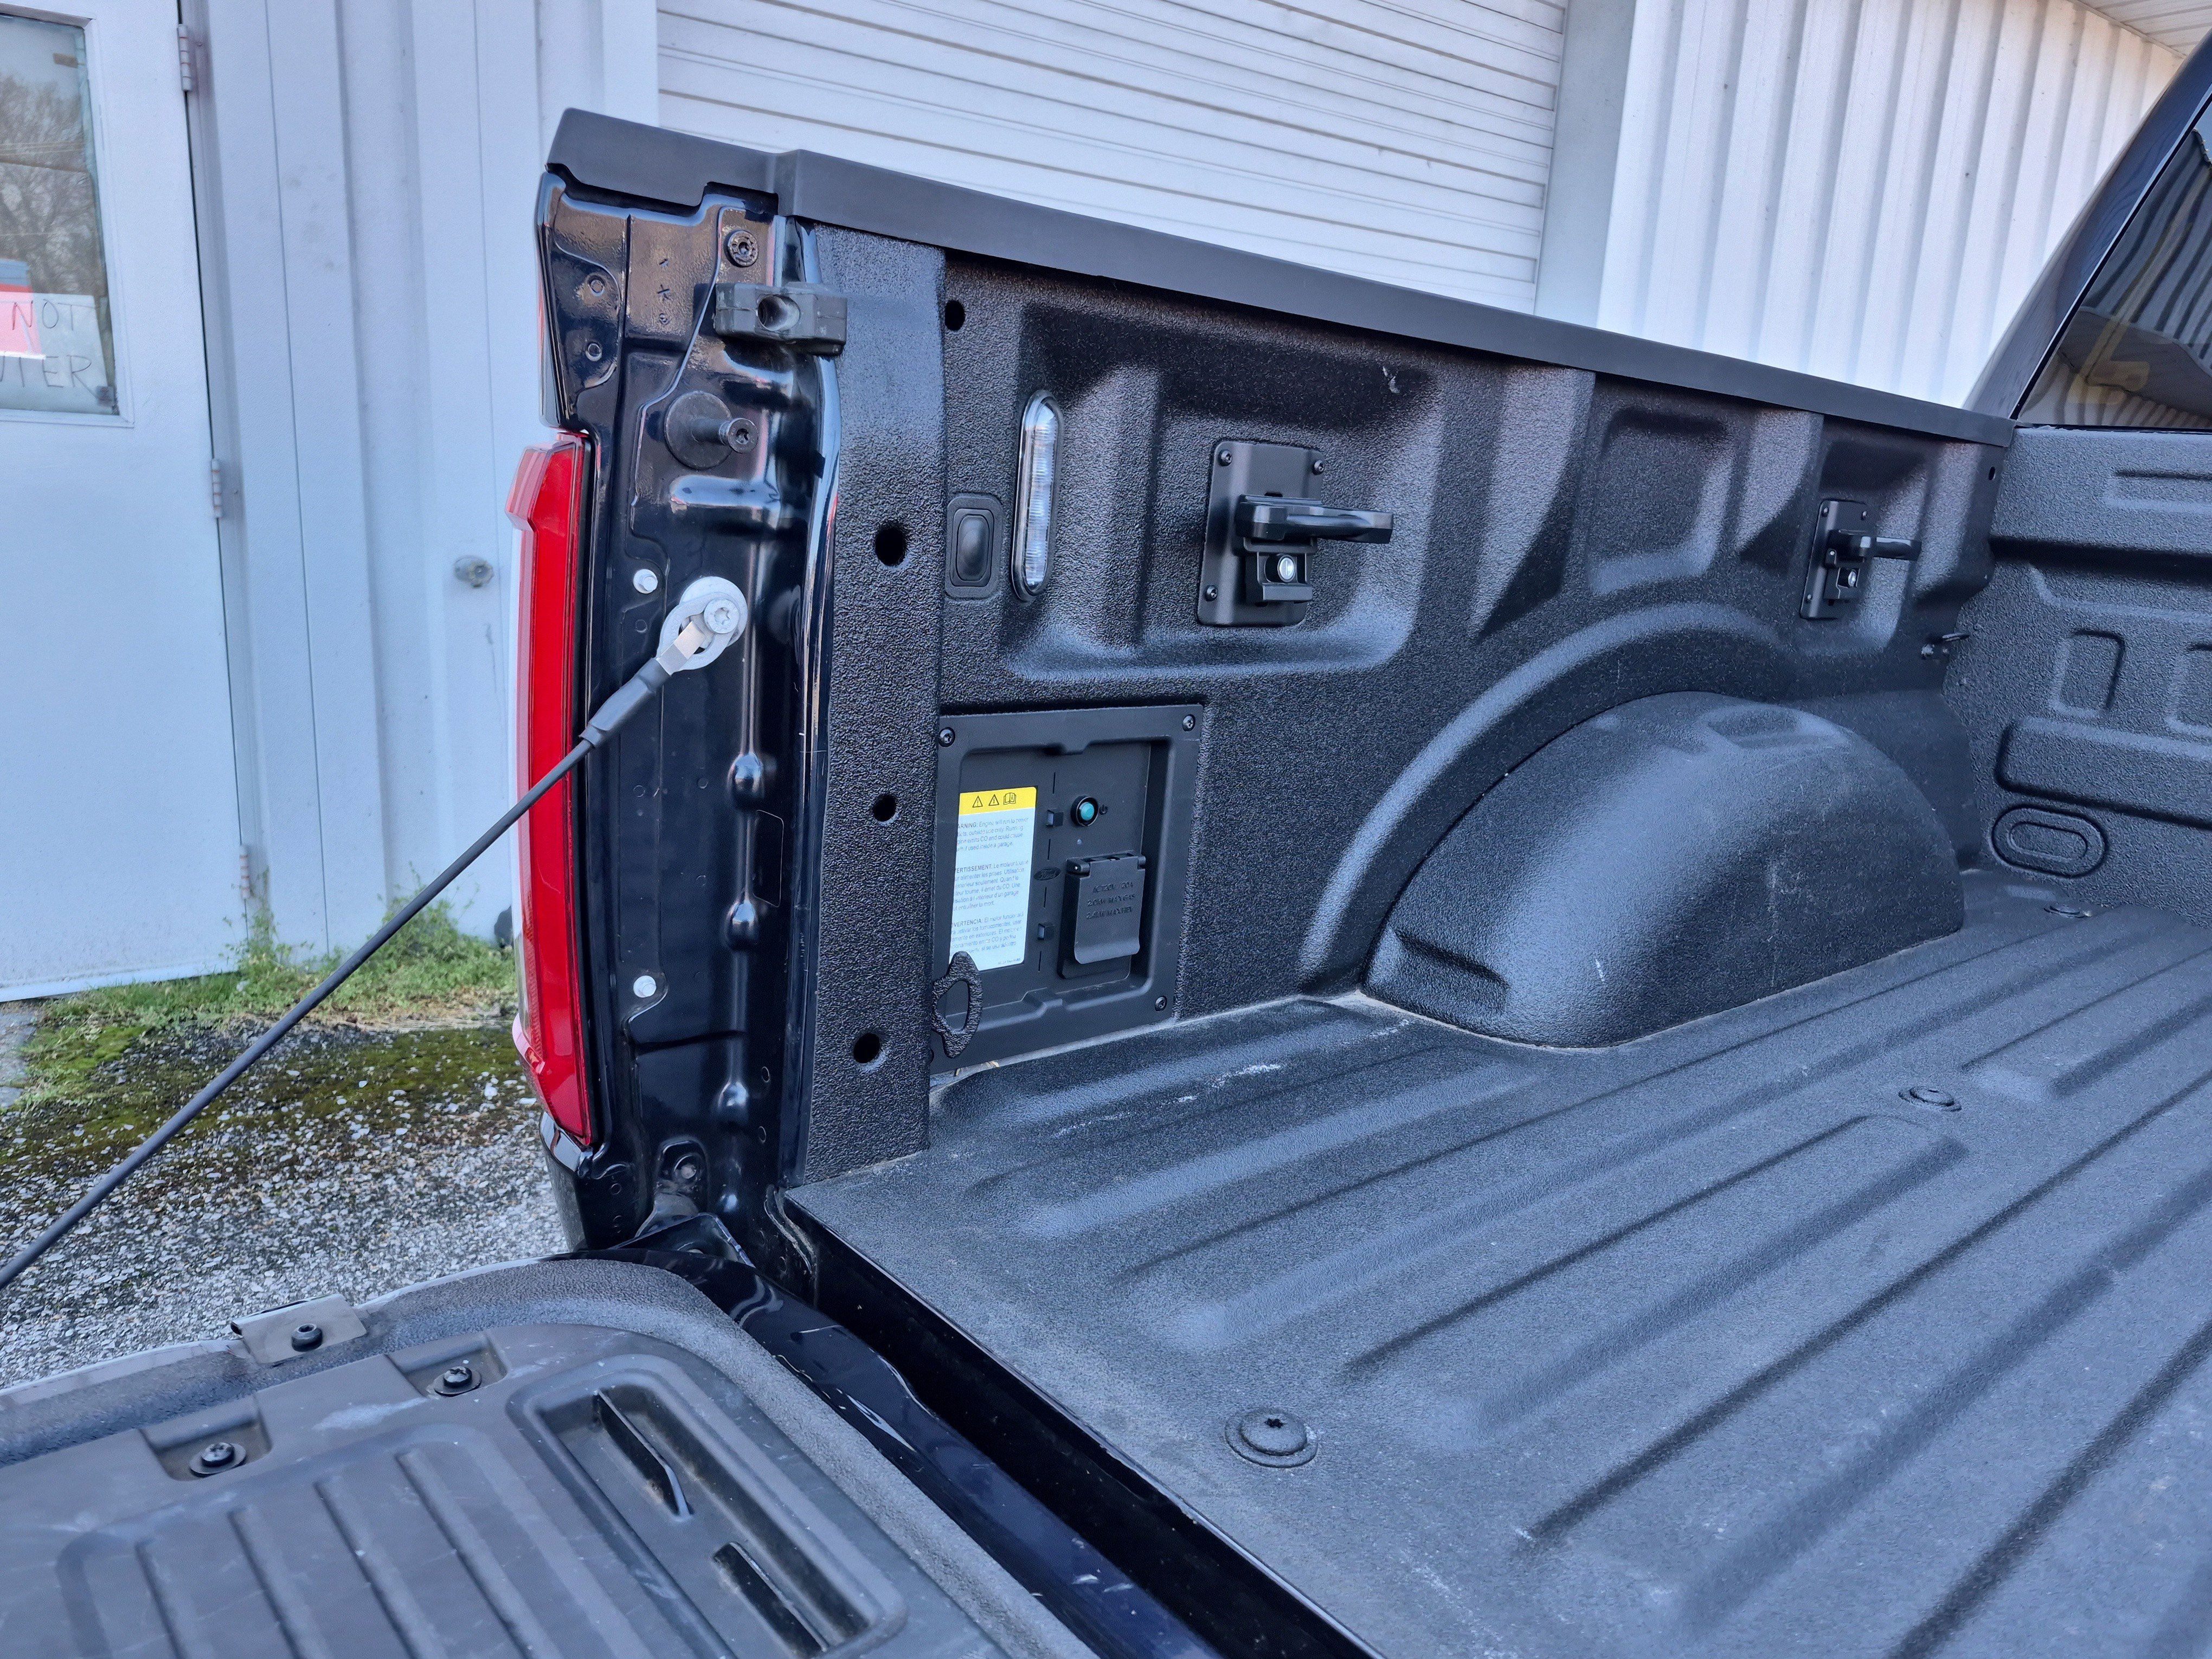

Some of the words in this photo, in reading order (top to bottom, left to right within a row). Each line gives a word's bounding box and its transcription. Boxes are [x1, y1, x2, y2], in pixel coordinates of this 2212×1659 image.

[12, 299, 97, 331] NOT
[0, 355, 97, 398] TER
[955, 864, 993, 873] ERTISSEMENT:
[1039, 869, 1057, 880] Ford
[1108, 895, 1122, 904] MAX
[1107, 907, 1121, 917] MAX
